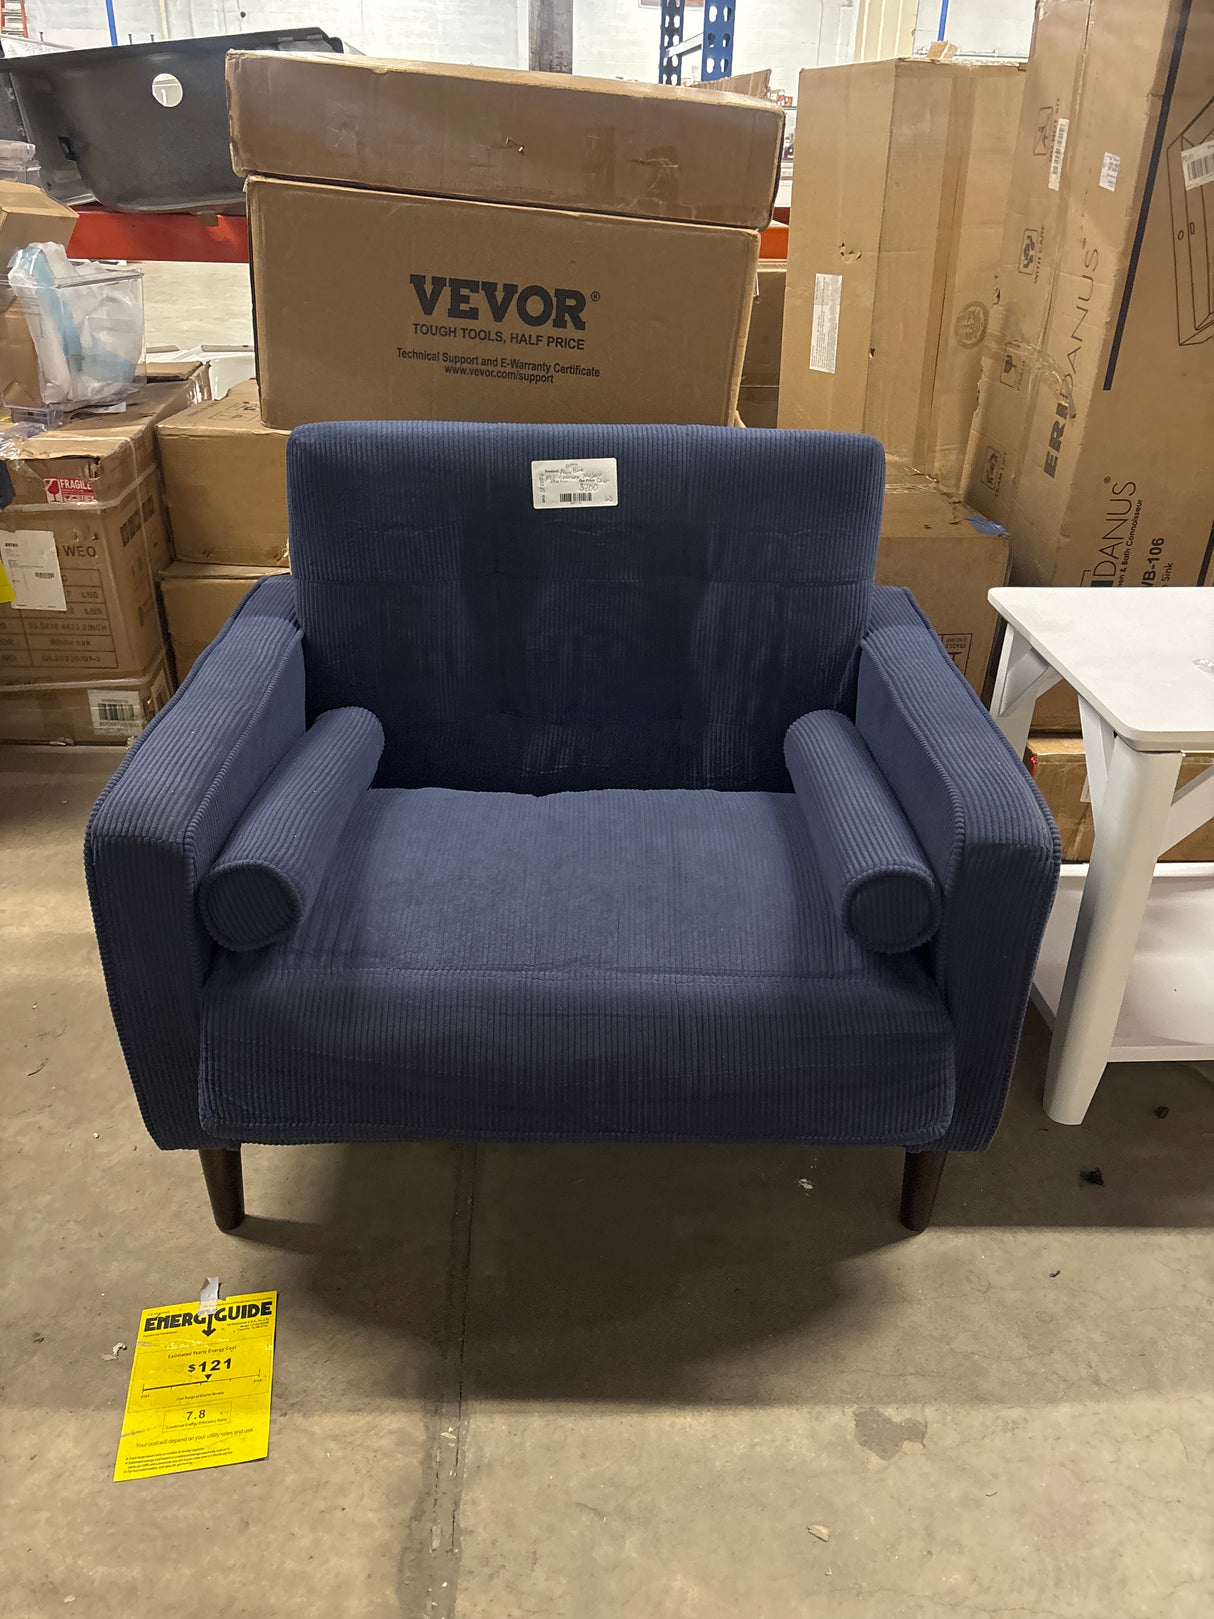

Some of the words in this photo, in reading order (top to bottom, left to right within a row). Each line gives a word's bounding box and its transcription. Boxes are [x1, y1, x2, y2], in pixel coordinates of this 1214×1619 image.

[410, 274, 586, 330] VEVOR
[412, 323, 457, 338] TOUGH
[460, 328, 506, 344] TOOLS,
[510, 333, 543, 346] HALF
[547, 336, 585, 350] PRICE
[396, 348, 440, 362] Technical
[442, 352, 479, 367] Support
[481, 357, 498, 368] and
[500, 358, 551, 374] E-Warranty
[553, 363, 600, 377] Certificate
[444, 365, 554, 384] www.vevor.com/support
[60, 480, 92, 490] FRAGILE
[1126, 499, 1143, 546] Connoisseur
[1161, 563, 1173, 582] Sink
[188, 1358, 232, 1373] $121
[186, 1409, 205, 1420] 7.8
